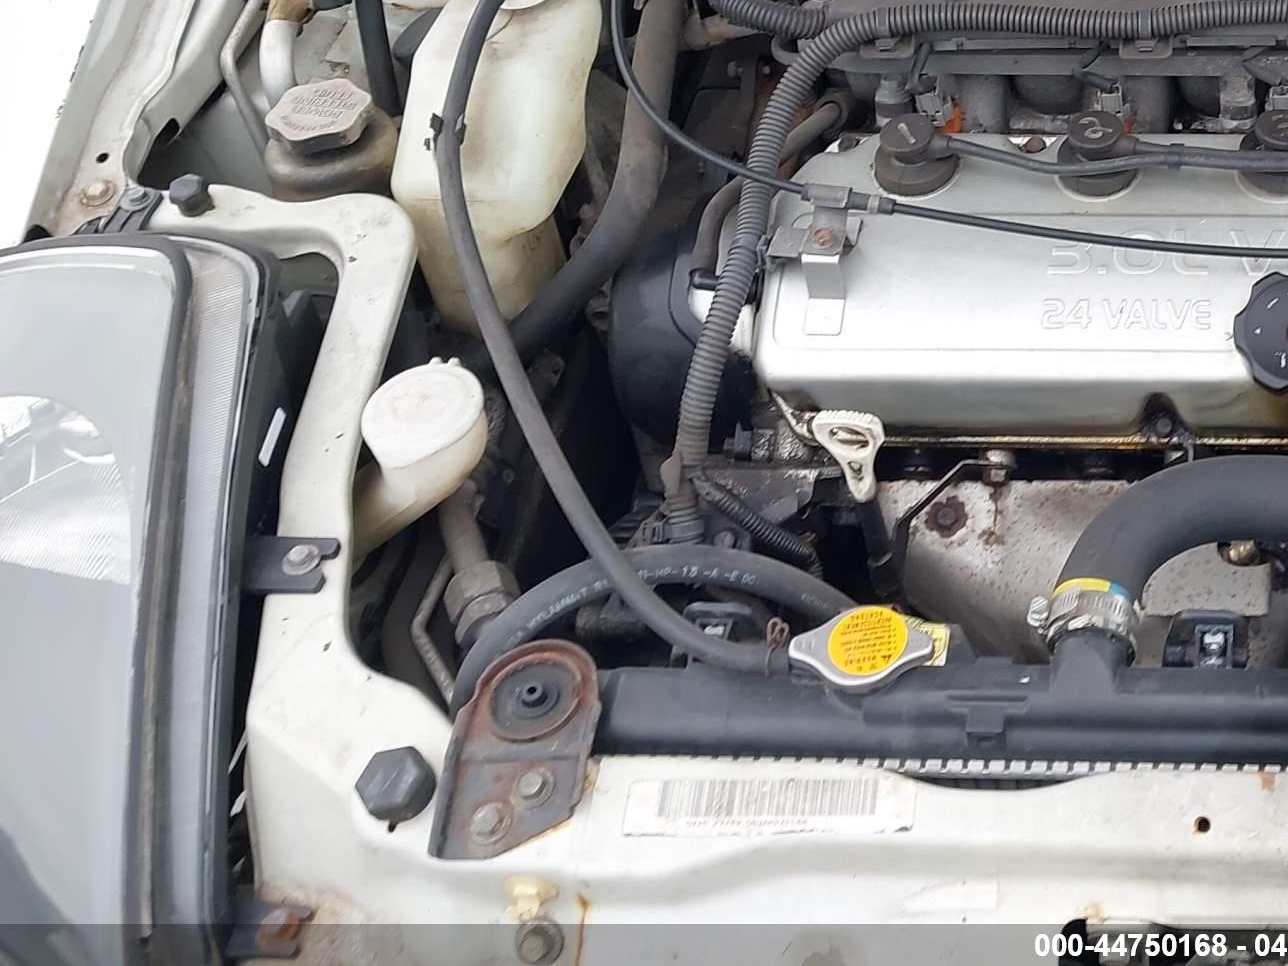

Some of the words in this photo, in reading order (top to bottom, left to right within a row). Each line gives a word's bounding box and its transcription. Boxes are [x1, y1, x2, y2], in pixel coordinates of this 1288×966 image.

[1047, 228, 1209, 276] 3.0L
[1041, 297, 1093, 331] 24
[1102, 297, 1212, 331] VALVE
